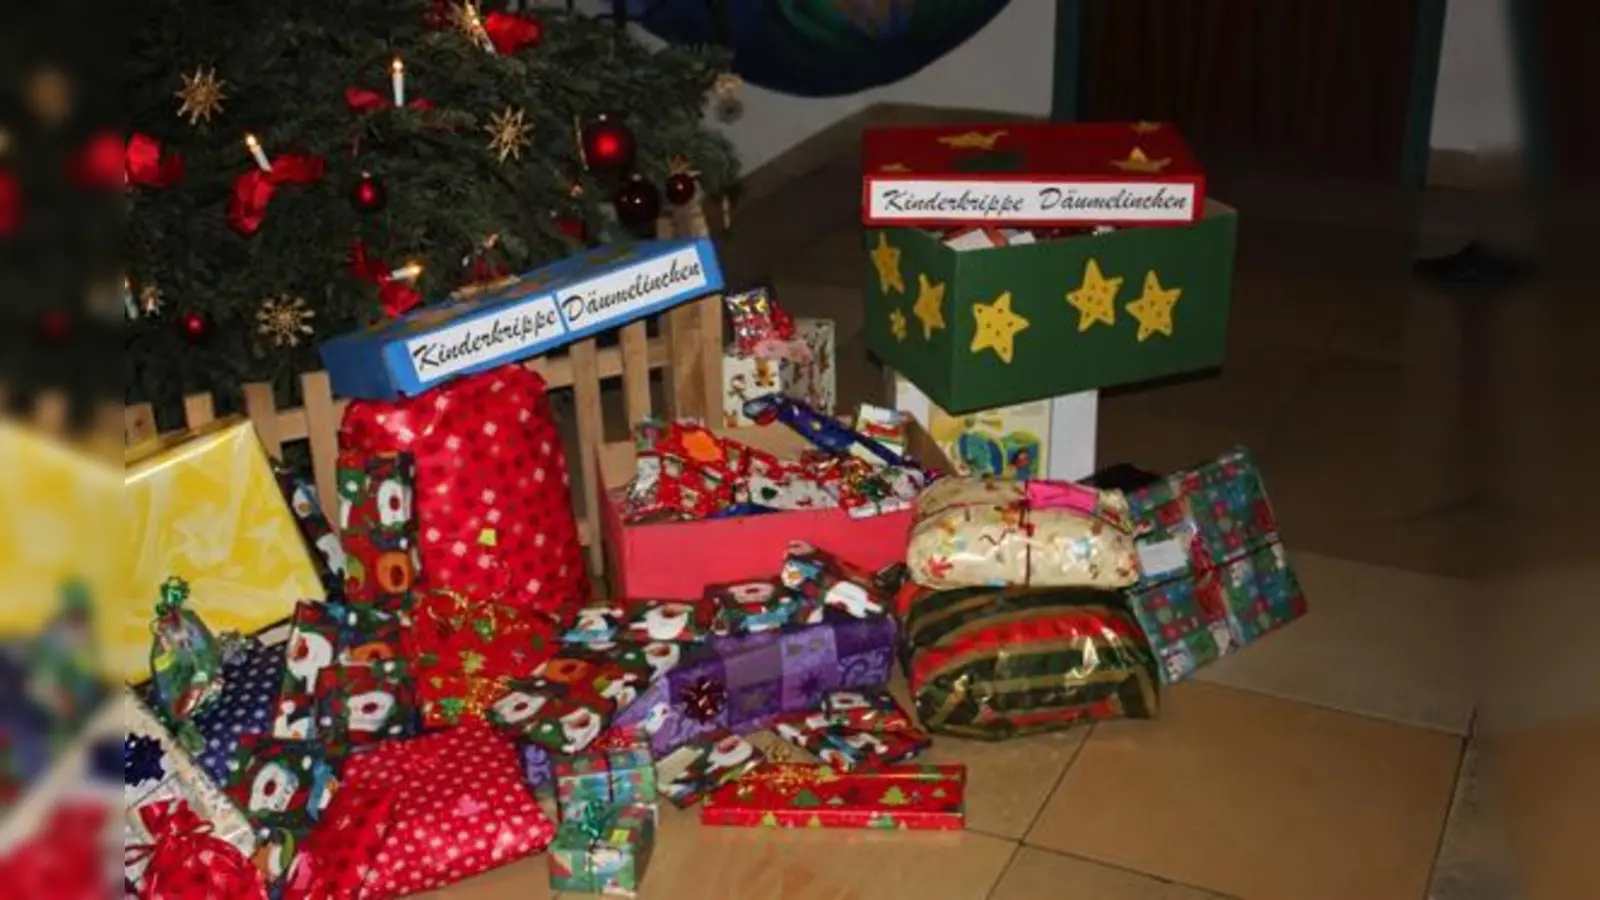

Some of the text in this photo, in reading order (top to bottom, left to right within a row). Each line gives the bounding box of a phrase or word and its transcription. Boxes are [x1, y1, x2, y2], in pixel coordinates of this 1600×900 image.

[882, 187, 1187, 216] Kinderkrippe Däumelinchen
[413, 258, 701, 371] Kinderkrippe Däumelinchen
